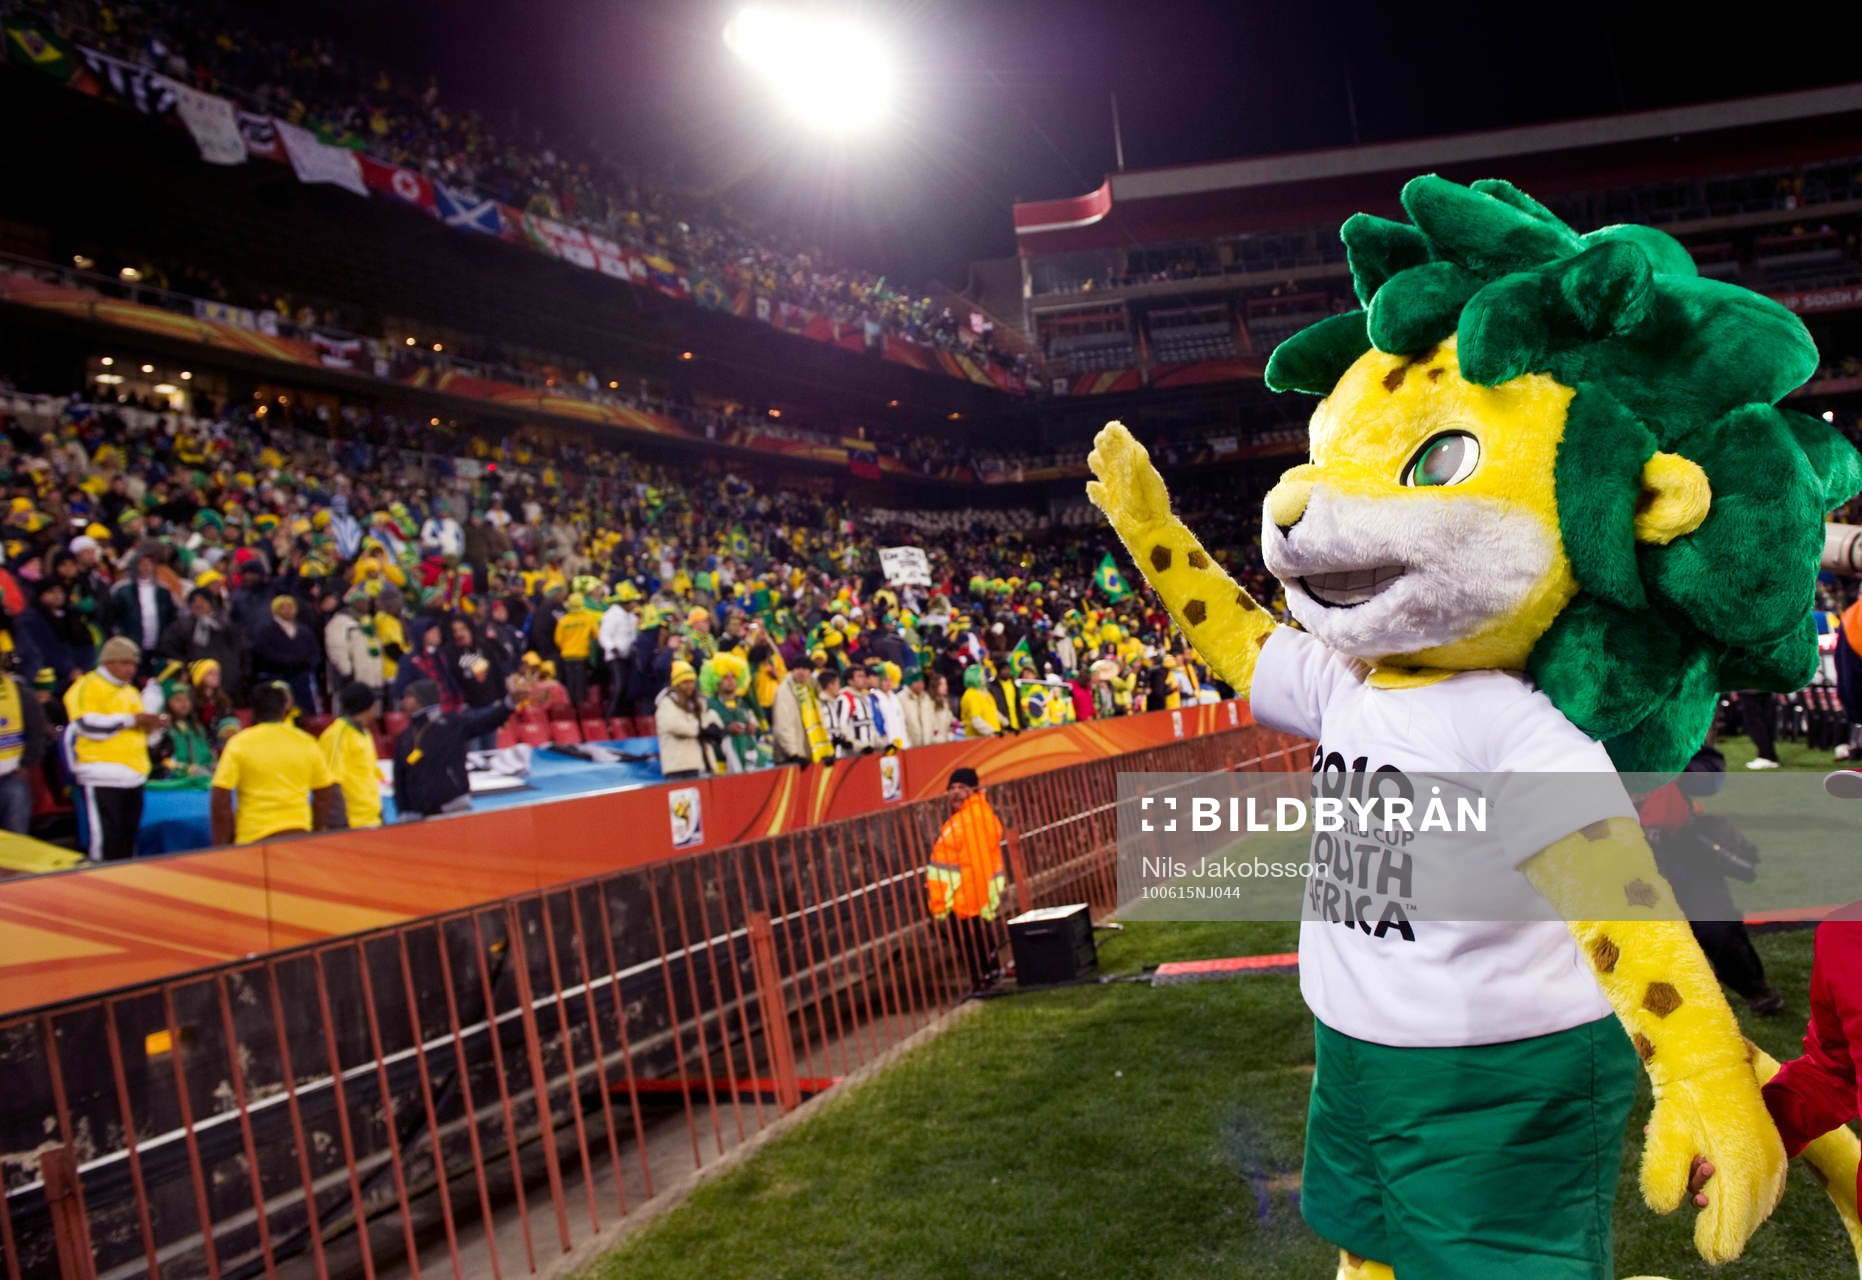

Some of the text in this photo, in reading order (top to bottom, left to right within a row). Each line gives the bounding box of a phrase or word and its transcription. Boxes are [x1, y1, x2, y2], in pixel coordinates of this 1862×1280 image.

[1310, 744, 1415, 821] 2010
[1314, 831, 1413, 898] OUTH
[1373, 828, 1415, 847] CUP
